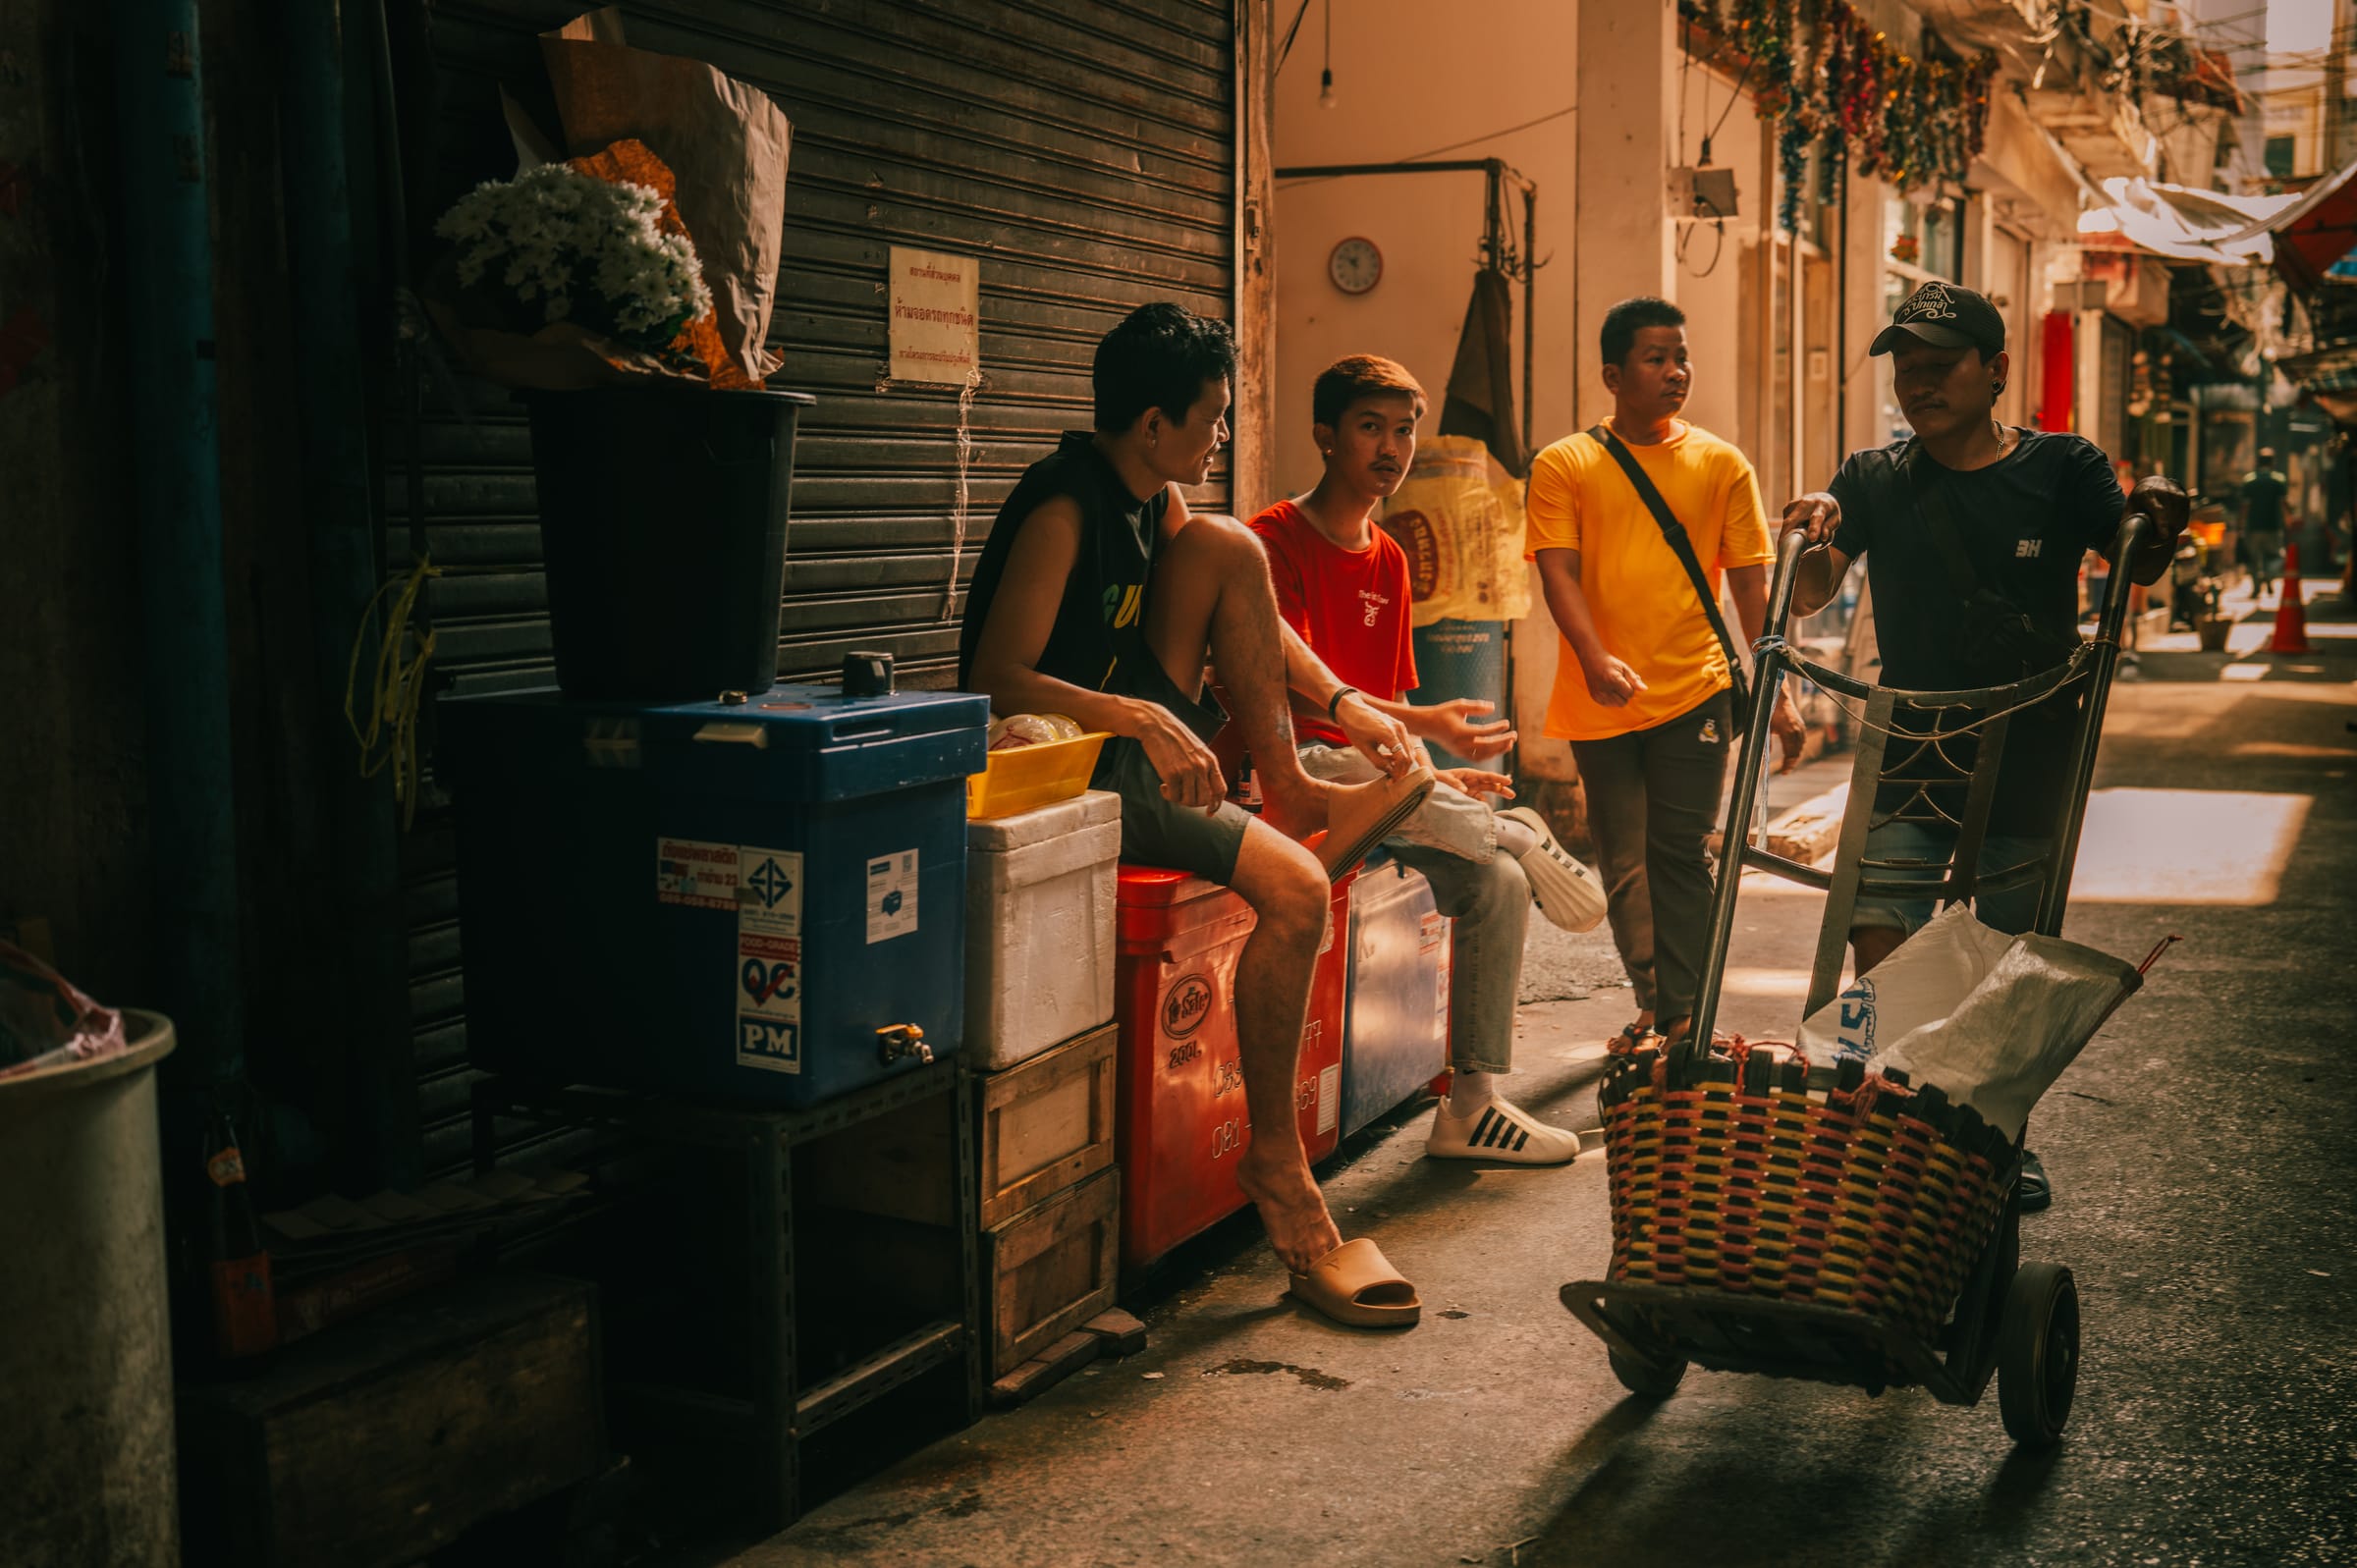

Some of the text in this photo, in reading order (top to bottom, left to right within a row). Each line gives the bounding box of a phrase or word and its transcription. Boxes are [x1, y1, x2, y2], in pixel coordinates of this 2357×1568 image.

[895, 297, 974, 330] ห้ามจอดรถทุกชนิด
[742, 958, 795, 1003] QC
[742, 1022, 794, 1056] PM
